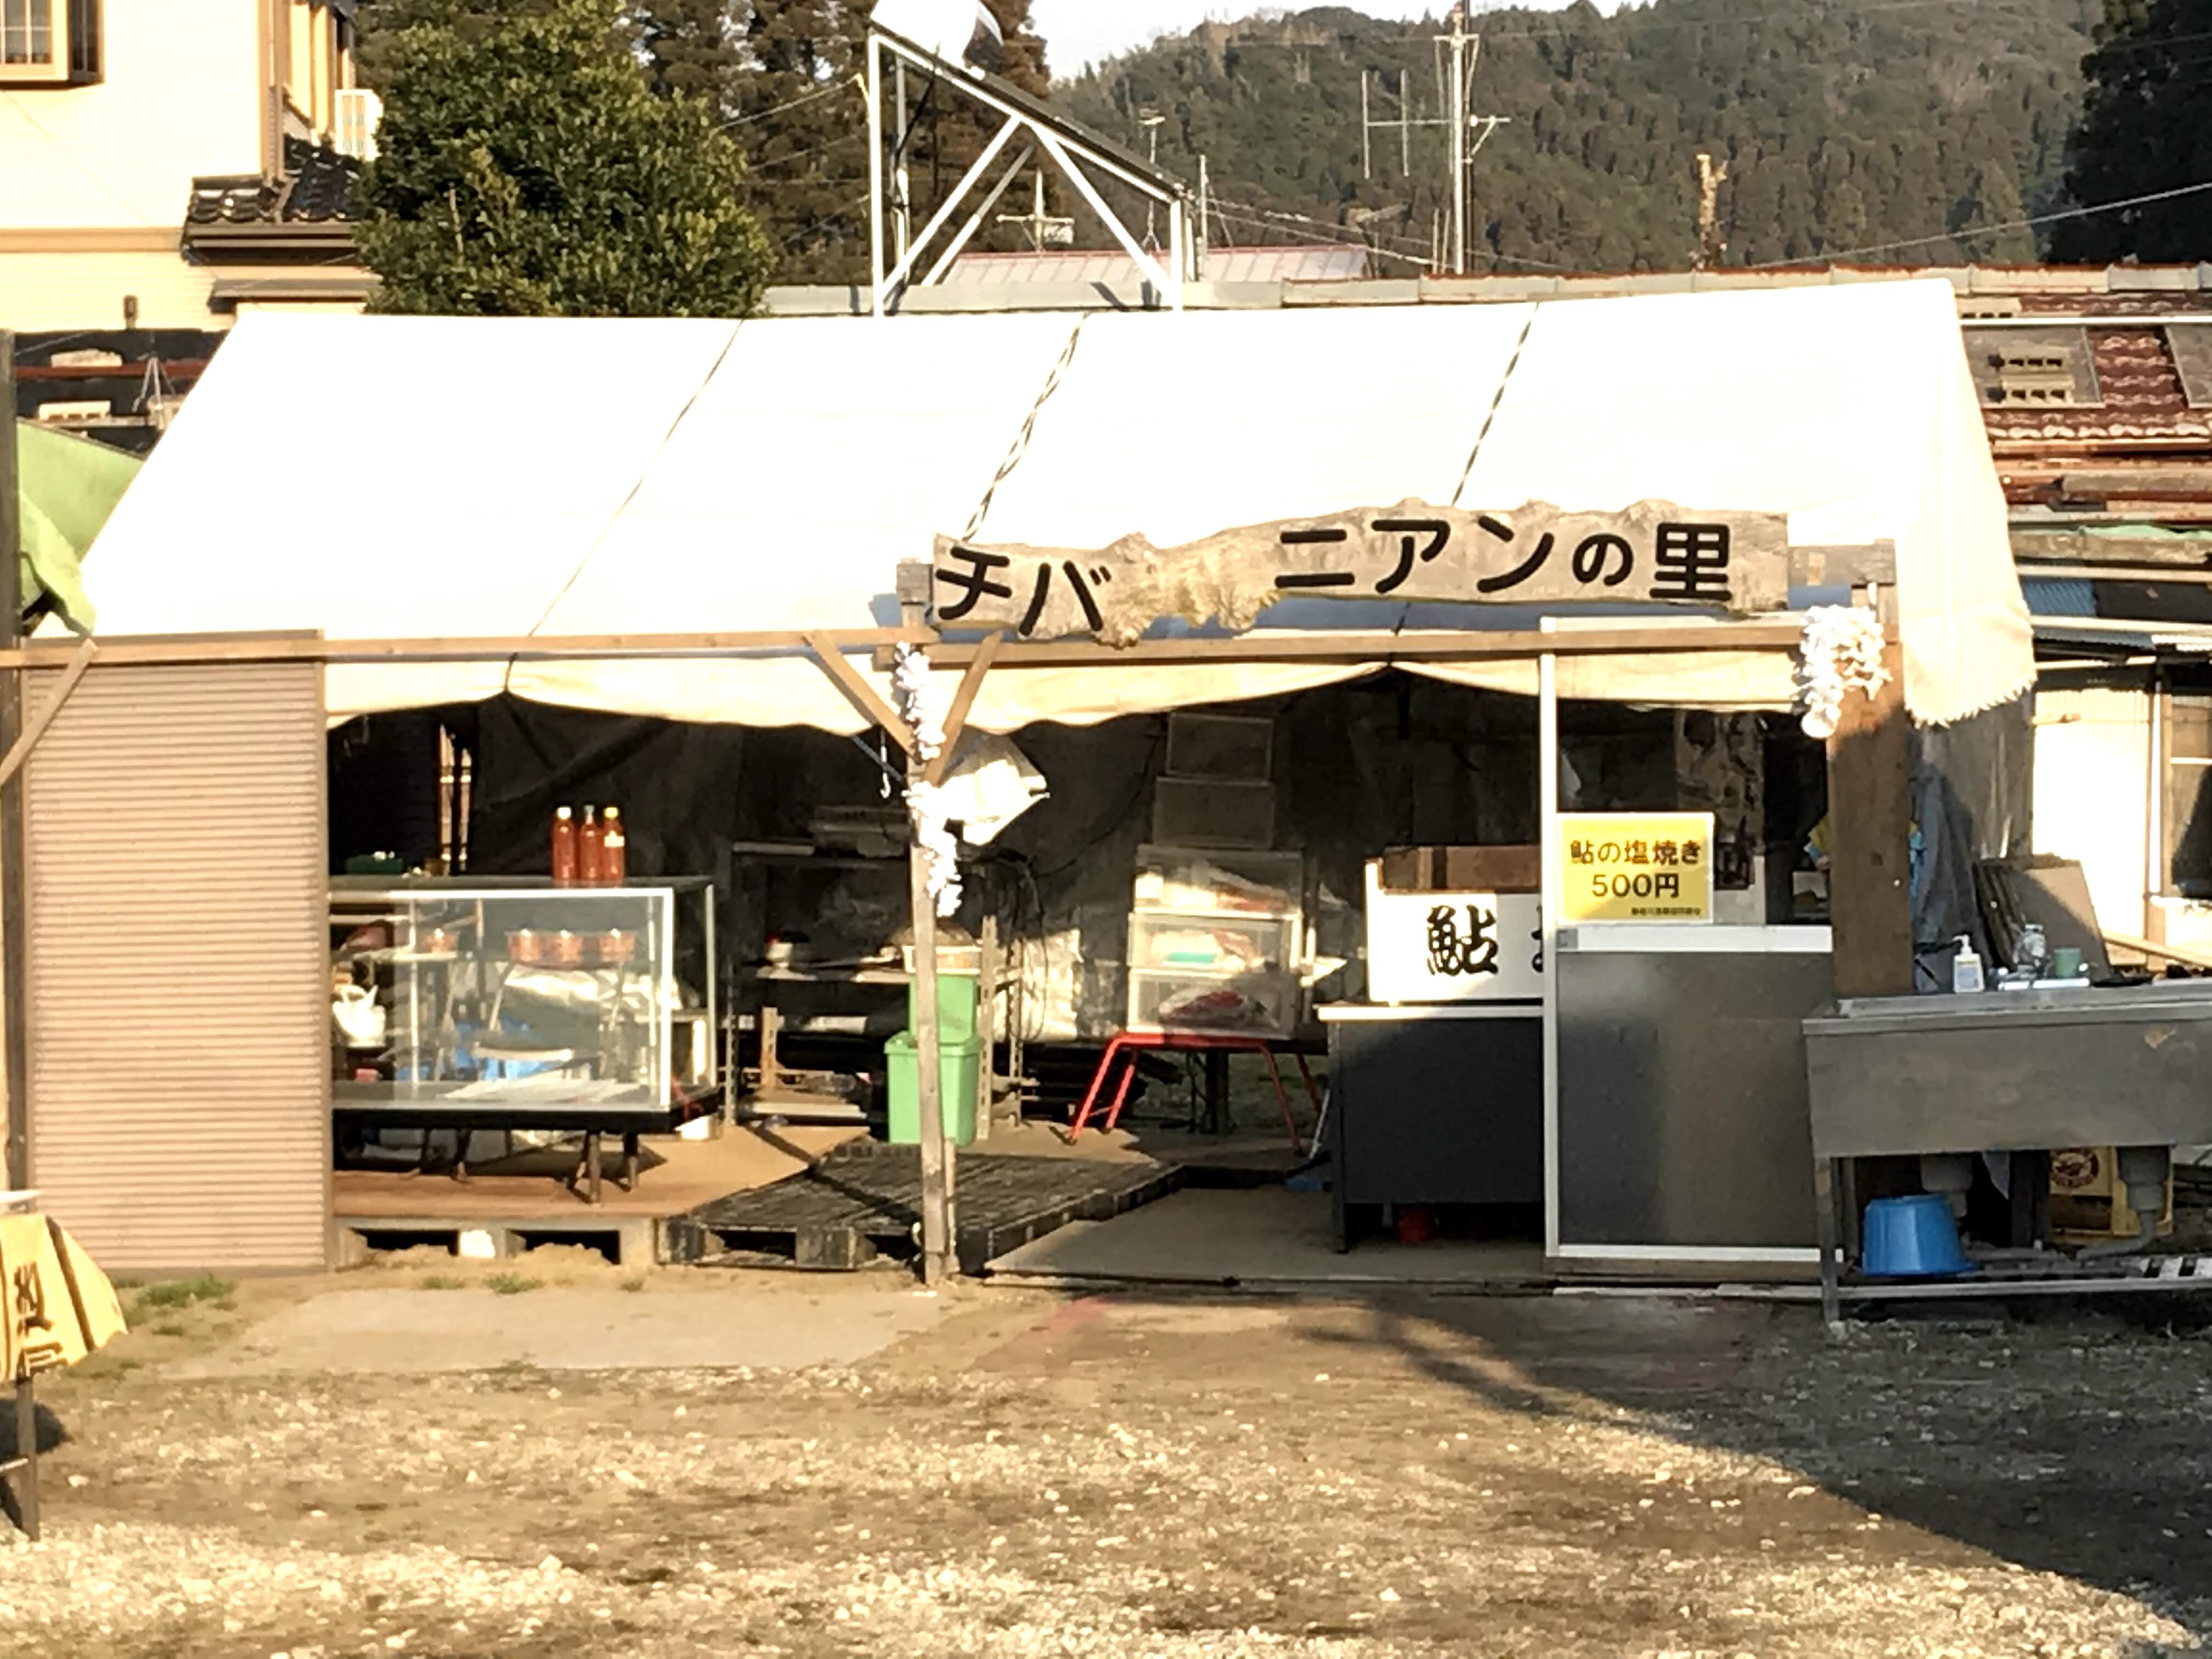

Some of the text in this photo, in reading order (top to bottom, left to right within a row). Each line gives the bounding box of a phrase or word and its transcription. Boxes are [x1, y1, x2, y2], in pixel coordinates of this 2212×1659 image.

[935, 515, 1733, 636] チバニアンの里
[1570, 839, 1701, 865] 鮎の塩焼き
[1592, 873, 1679, 899] 500円
[1426, 904, 1543, 977] 鮎
